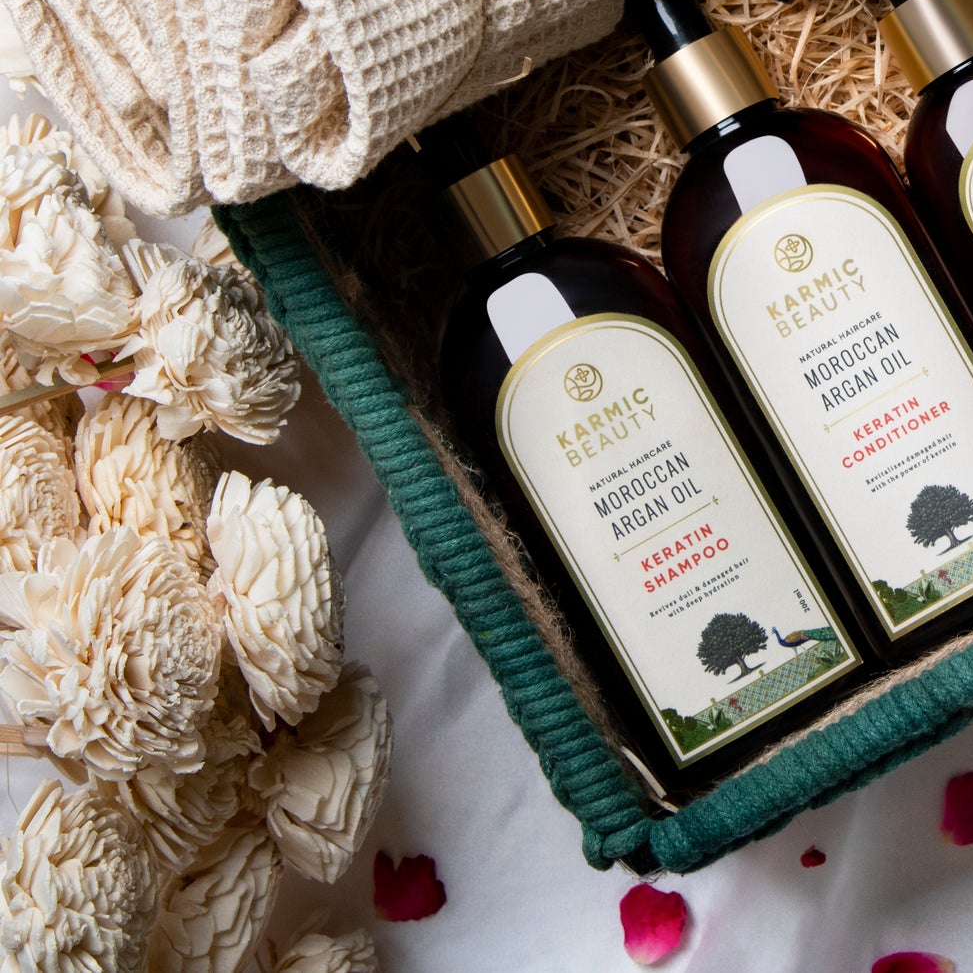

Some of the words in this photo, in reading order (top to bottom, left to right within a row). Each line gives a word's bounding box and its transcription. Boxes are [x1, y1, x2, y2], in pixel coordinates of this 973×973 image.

[765, 258, 859, 321] KARMIC
[775, 274, 865, 339] BEAUTY
[798, 338, 838, 364] NATURAL
[838, 311, 882, 340] HAIRCARE
[803, 323, 900, 389] MOROCCAN
[821, 366, 878, 412] ARGAN
[880, 349, 912, 375] OIL
[555, 387, 649, 449] KARMIC
[565, 403, 656, 468] BEAUTY
[841, 401, 950, 469] CONDITIONER
[852, 396, 920, 441] KERATIN
[589, 467, 628, 492] NATURAL
[628, 440, 672, 469] HAIRCARE
[593, 451, 690, 518] MOROCCAN
[865, 460, 905, 485] Revitalizes
[905, 441, 937, 462] damaged
[936, 433, 952, 444] hair
[870, 481, 887, 493] with
[886, 474, 899, 484] the
[899, 461, 921, 478] power
[921, 455, 930, 464] of
[929, 441, 957, 459] keratin
[611, 495, 669, 541] ARGAN
[670, 477, 702, 504] OIL
[640, 523, 713, 572] KERATIN
[644, 537, 729, 593] SHAMPOO
[649, 599, 677, 618] Revives
[678, 589, 694, 601] dull
[702, 566, 733, 588] damaged
[733, 557, 749, 569] hair
[667, 606, 685, 618] with
[685, 595, 703, 608] deep
[703, 574, 740, 598] hydration
[792, 588, 803, 599] ml
[799, 599, 810, 613] 200
